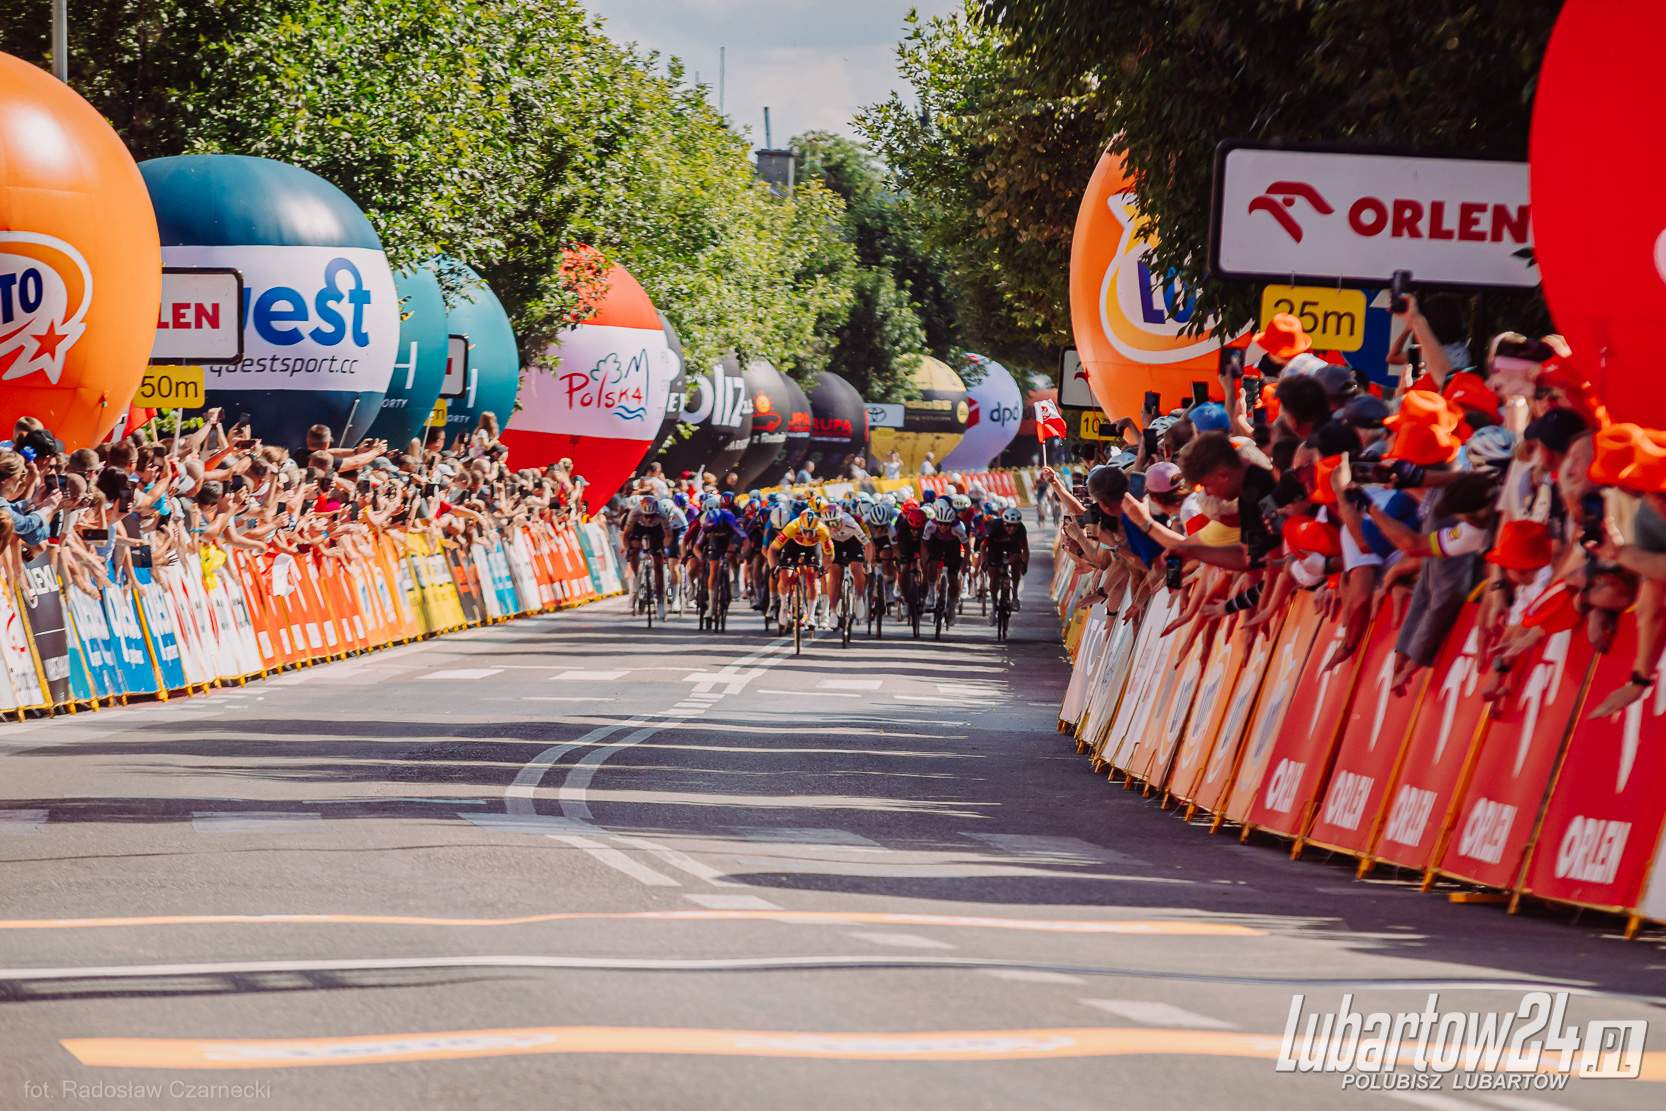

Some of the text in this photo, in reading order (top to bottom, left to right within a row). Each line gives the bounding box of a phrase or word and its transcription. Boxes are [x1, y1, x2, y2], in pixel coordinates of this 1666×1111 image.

[1349, 196, 1532, 244] ORLEN
[0, 267, 43, 325] TO
[243, 257, 371, 348] est
[140, 375, 199, 398] 50m
[1553, 815, 1633, 885] ORLEN
